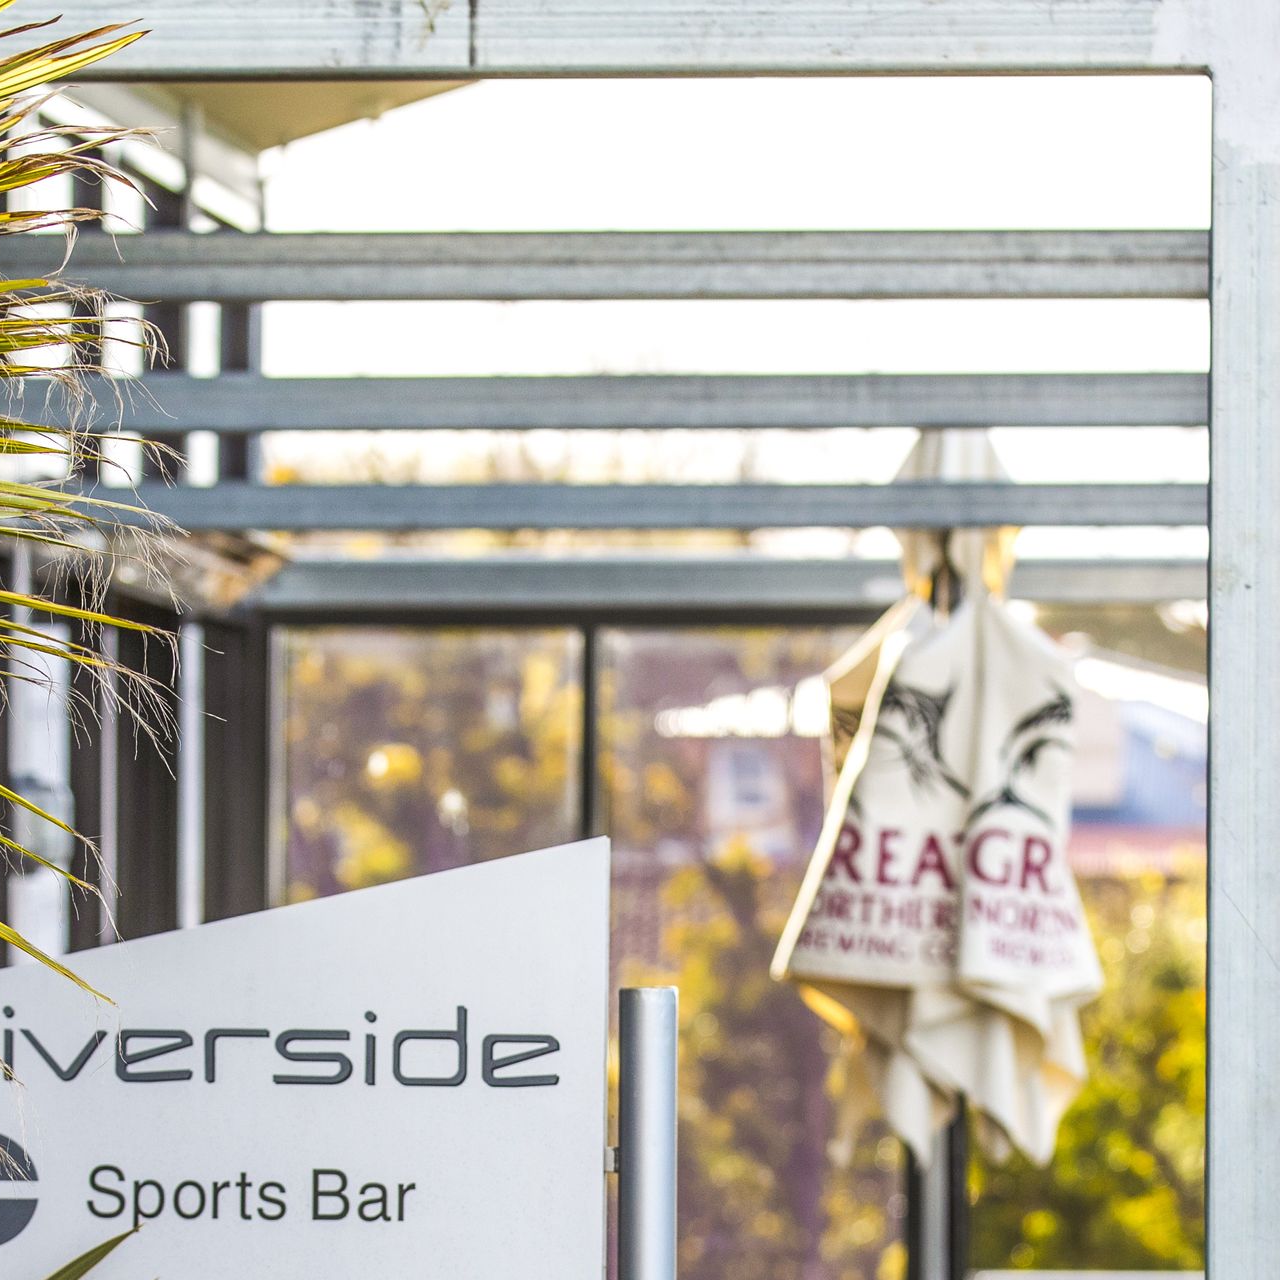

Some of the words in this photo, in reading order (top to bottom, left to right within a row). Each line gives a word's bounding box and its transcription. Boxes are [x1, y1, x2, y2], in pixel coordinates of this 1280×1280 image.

[967, 828, 1065, 894] GR
[87, 1164, 287, 1230] Sports
[312, 1168, 417, 1222] Bar
